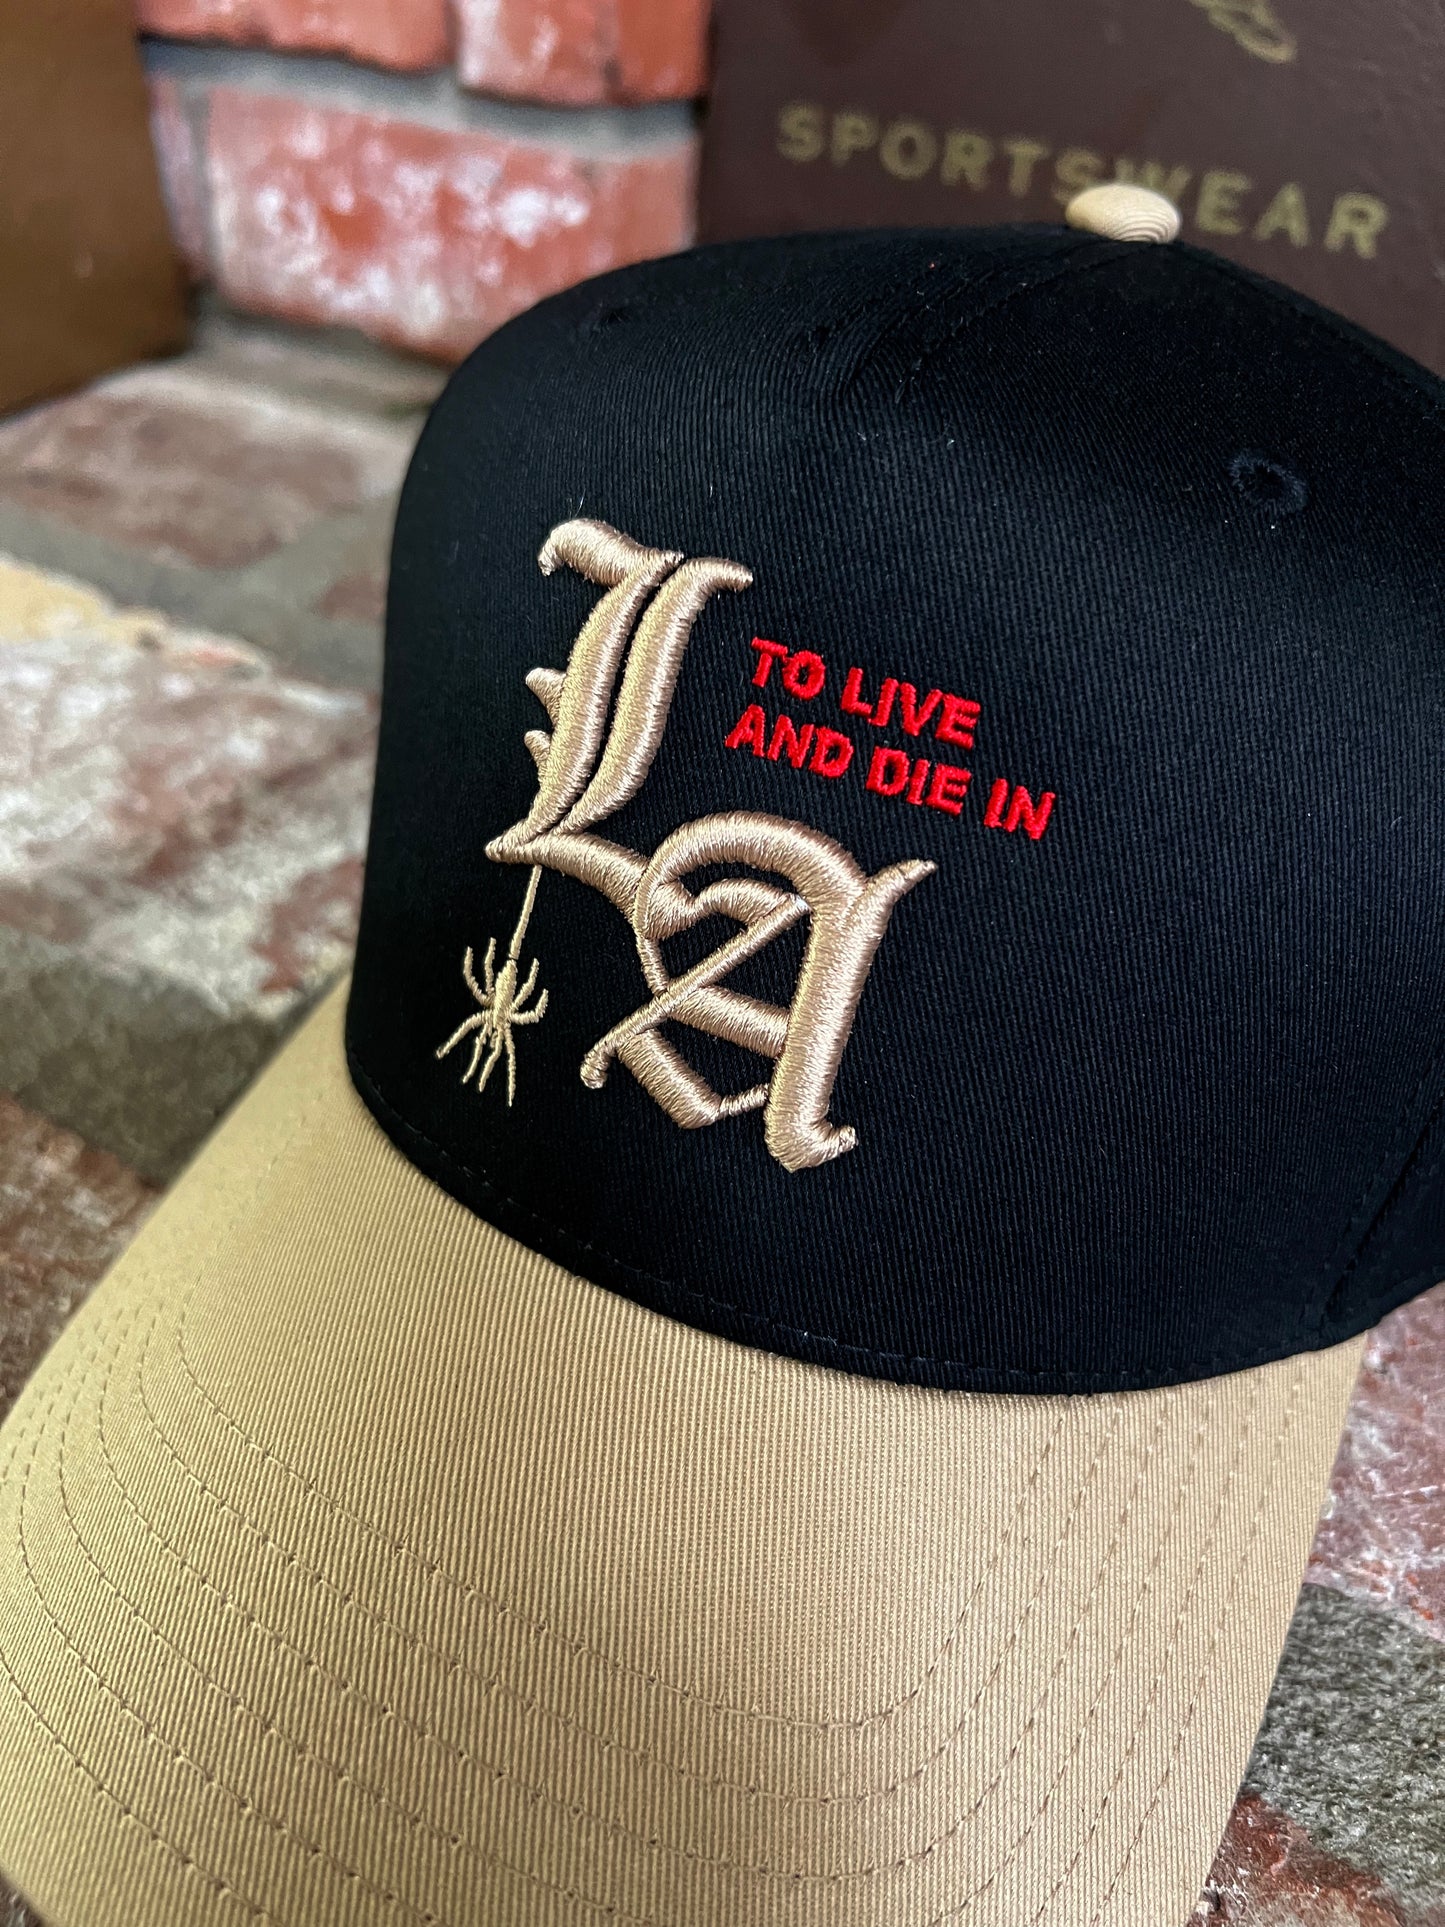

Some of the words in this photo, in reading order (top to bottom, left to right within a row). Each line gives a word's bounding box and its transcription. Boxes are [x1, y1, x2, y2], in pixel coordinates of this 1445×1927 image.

[751, 636, 826, 700] TO
[840, 667, 981, 749] LIVE
[724, 704, 854, 778] AND
[865, 745, 972, 816] DIE
[983, 777, 1056, 841] IN
